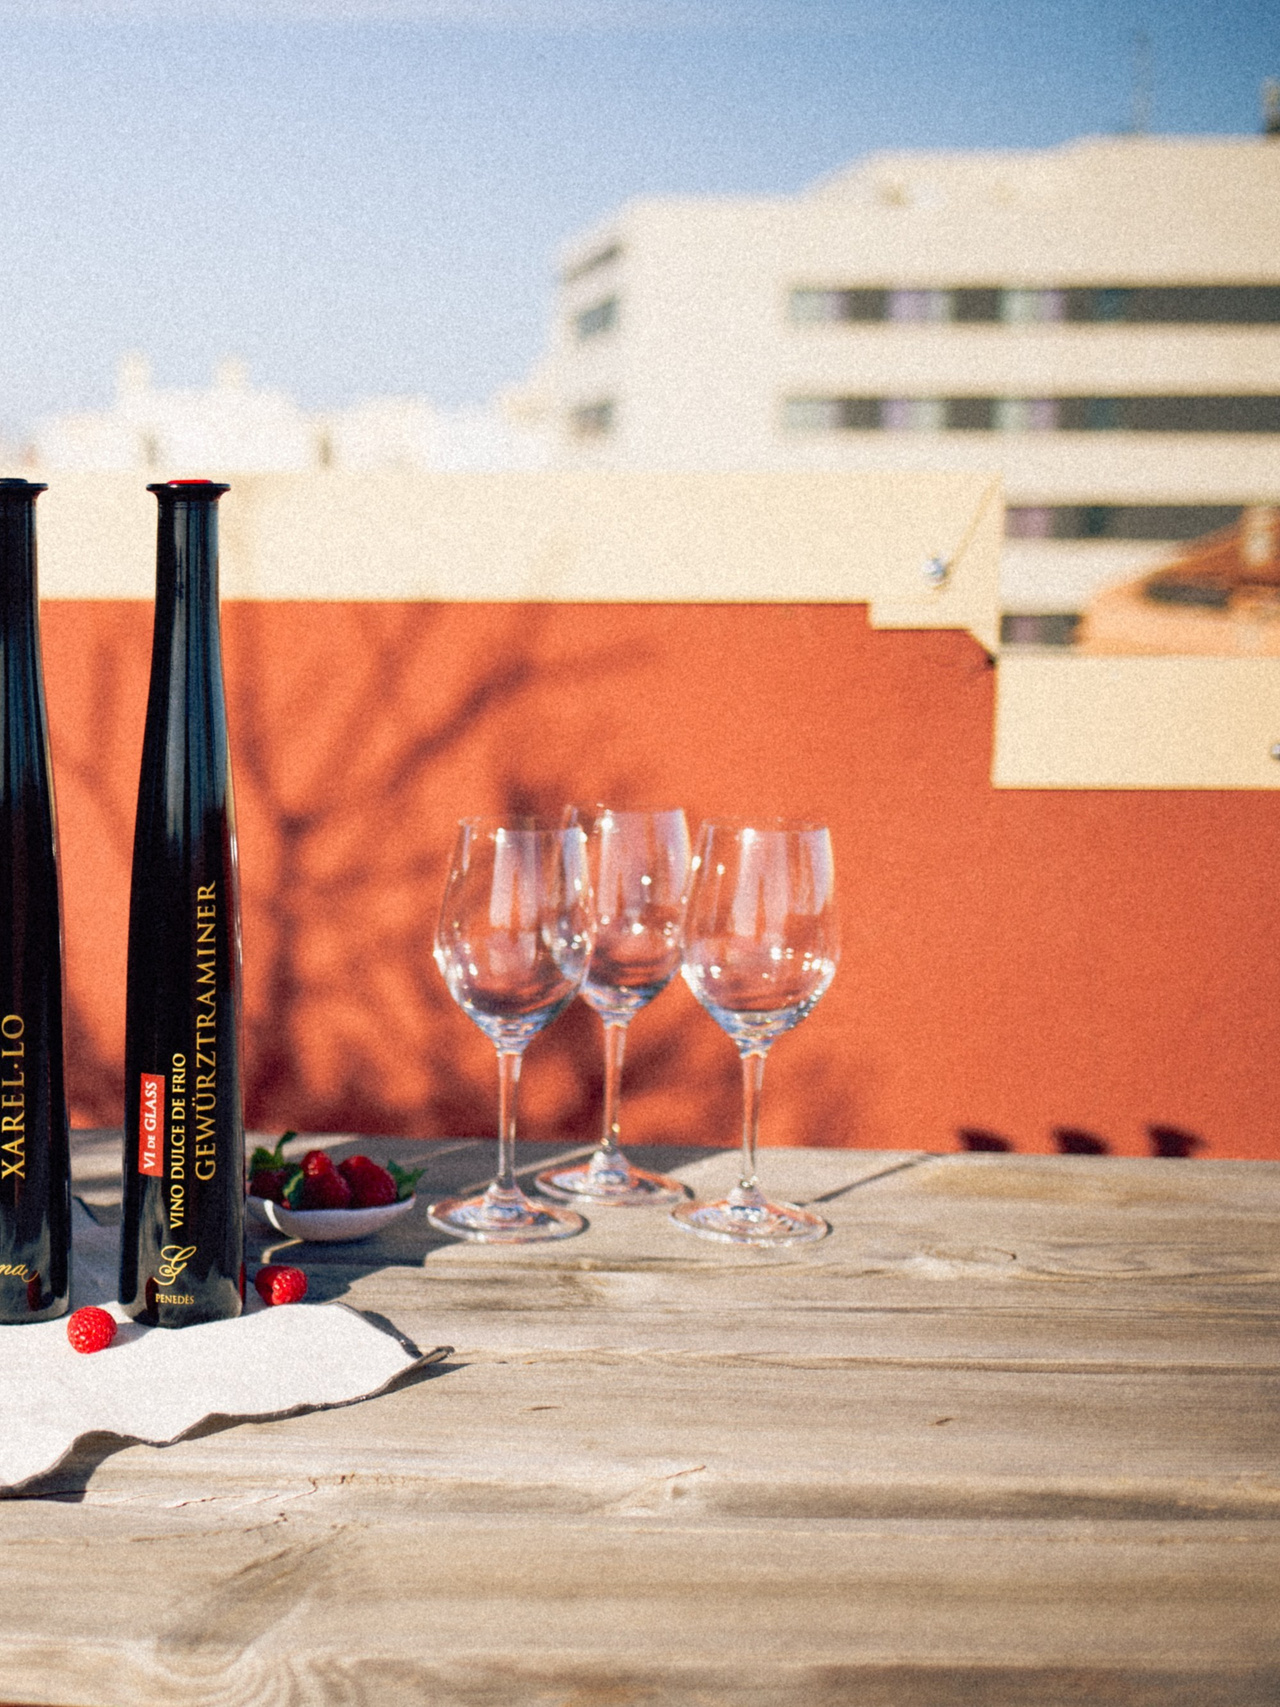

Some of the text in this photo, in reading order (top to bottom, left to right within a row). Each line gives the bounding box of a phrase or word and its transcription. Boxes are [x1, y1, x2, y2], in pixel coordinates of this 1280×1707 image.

[191, 880, 217, 1180] GEWÜRZTRAMINER
[144, 1081, 158, 1132] GLASS
[143, 1151, 156, 1170] VI
[170, 1052, 187, 1230] VINO DULCE DE FRIO
[155, 1293, 195, 1305] PENEDÈS
